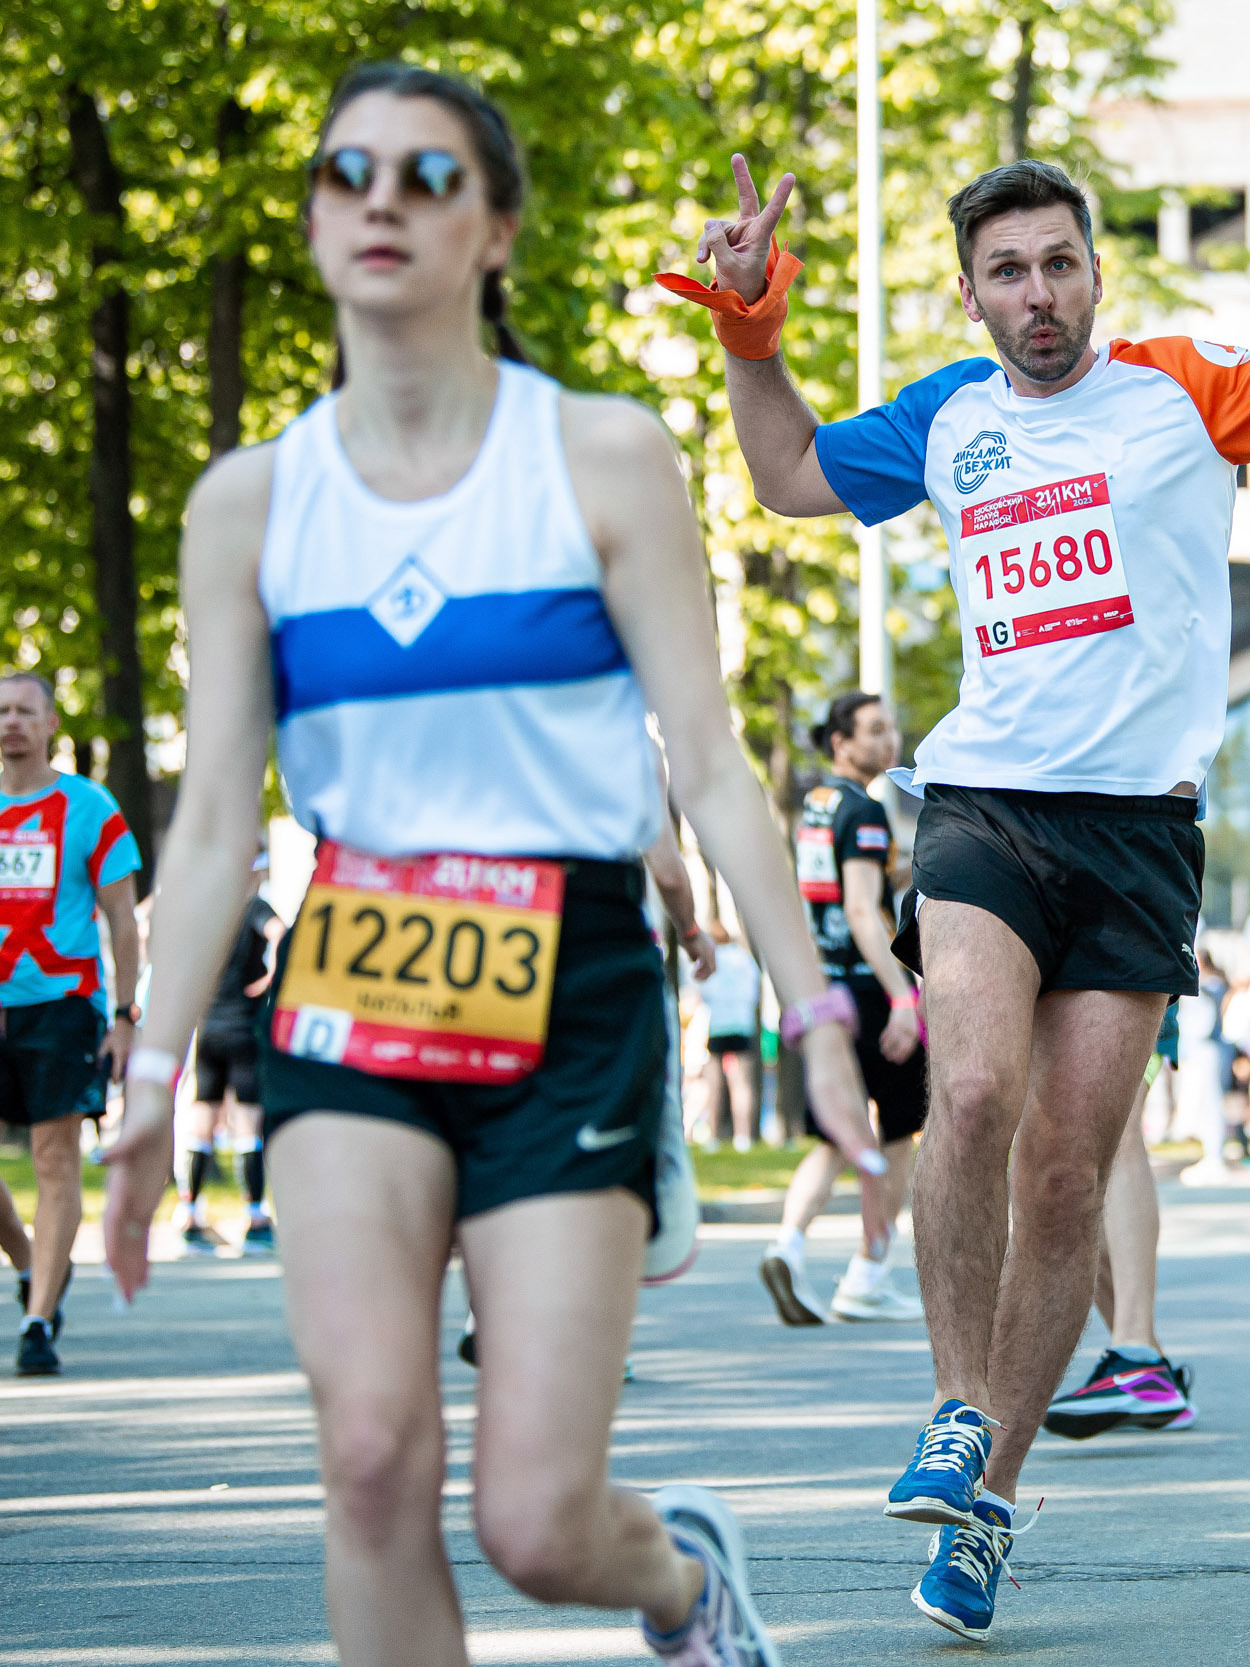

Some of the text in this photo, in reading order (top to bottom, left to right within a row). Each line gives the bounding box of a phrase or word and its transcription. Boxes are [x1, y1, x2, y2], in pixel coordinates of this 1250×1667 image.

[953, 445, 1006, 463] ДИНАМО
[964, 456, 1012, 474] БЕЖИТ
[973, 495, 1024, 517] МОСКОВСКИЙ
[1073, 496, 1093, 507] 2023
[973, 516, 1012, 531] МАРАФОН
[975, 529, 1113, 600] 15680
[992, 621, 1009, 645] G
[310, 900, 540, 997] 12203
